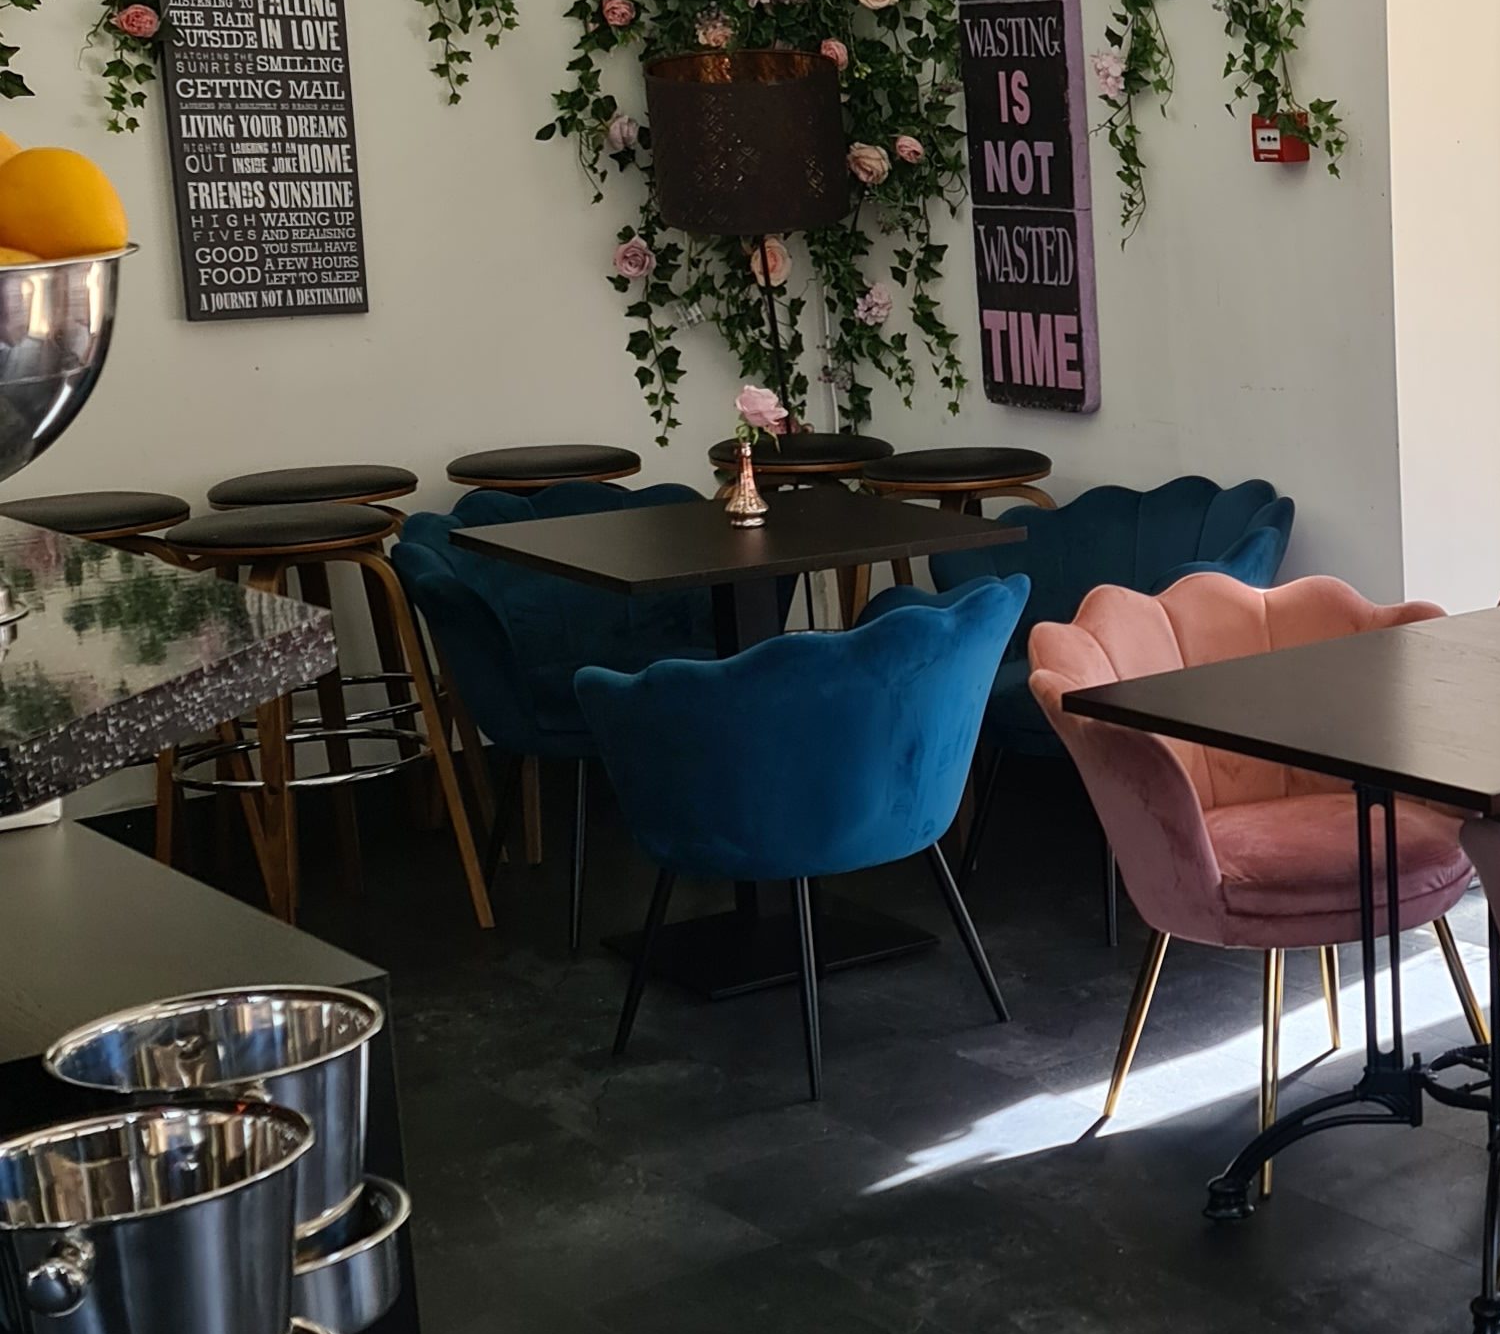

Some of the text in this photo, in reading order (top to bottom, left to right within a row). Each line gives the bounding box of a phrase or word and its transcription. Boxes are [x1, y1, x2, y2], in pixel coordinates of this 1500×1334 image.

[169, 10, 254, 27] THE RAIN
[260, 18, 341, 51] IN LOVE
[963, 16, 1061, 59] WASTING
[174, 52, 254, 61] WATCHING THE
[256, 55, 345, 73] SMILING
[176, 61, 255, 74] SUNRISE
[175, 78, 345, 100] GETTING MAIL
[998, 69, 1031, 125] IS
[179, 114, 348, 138] LIVING YOUR DREAMS
[183, 143, 225, 152] NIGHTS
[271, 142, 282, 154] AT
[285, 143, 297, 154] AN
[184, 153, 227, 174] OUT
[231, 157, 299, 174] INSIDE JOKE
[297, 144, 353, 174] HOME
[983, 139, 1055, 195] NOT
[187, 180, 354, 210] FRIENDS SUNSHINE
[191, 213, 256, 228] HIGH
[259, 211, 355, 227] WAKING UP
[193, 230, 257, 242] FIVES
[261, 228, 356, 241] AND REALISING
[195, 246, 259, 264] GOOD
[262, 241, 357, 255] YOU STILL HAVE
[978, 225, 1074, 286] WASTED
[264, 256, 359, 271] A FEW HOURS
[199, 266, 262, 286] FOOD
[265, 271, 360, 286] LEFT TO SLEEP
[200, 286, 363, 313] A JOURNEY NOT A DESTINATION
[982, 309, 1083, 390] TIME
